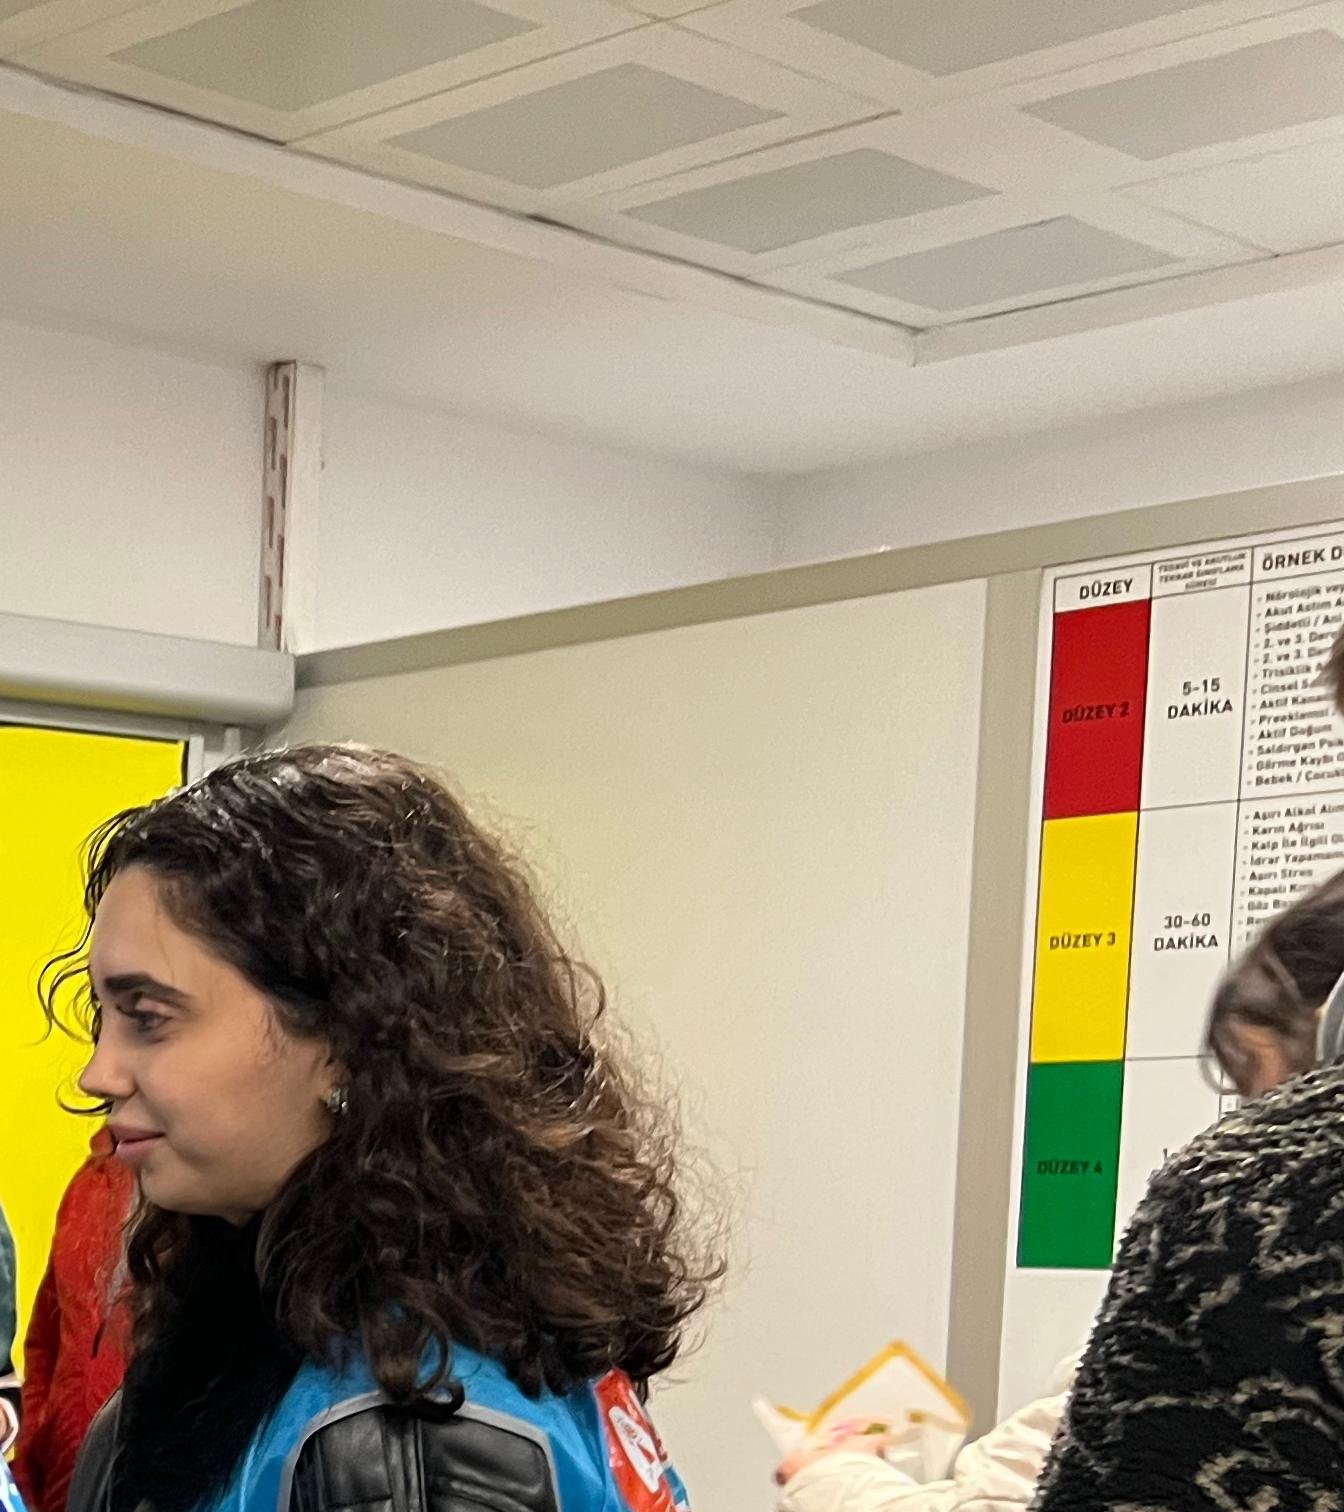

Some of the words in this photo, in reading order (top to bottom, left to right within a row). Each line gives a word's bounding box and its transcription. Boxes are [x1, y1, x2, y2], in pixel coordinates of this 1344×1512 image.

[1262, 548, 1325, 571] ÖRNEK
[1079, 578, 1134, 600] DÜZEY
[1182, 678, 1220, 696] 5-15
[1063, 704, 1117, 723] DÜZEY
[1119, 702, 1130, 717] 2
[1167, 698, 1233, 719] DAKİKA
[1164, 913, 1211, 929] 30-60
[1049, 933, 1102, 951] DÜZEY
[1107, 932, 1117, 946] 3
[1153, 930, 1219, 952] DAKİKA
[1037, 1158, 1089, 1175] DÜZEY
[1092, 1159, 1103, 1175] 4
